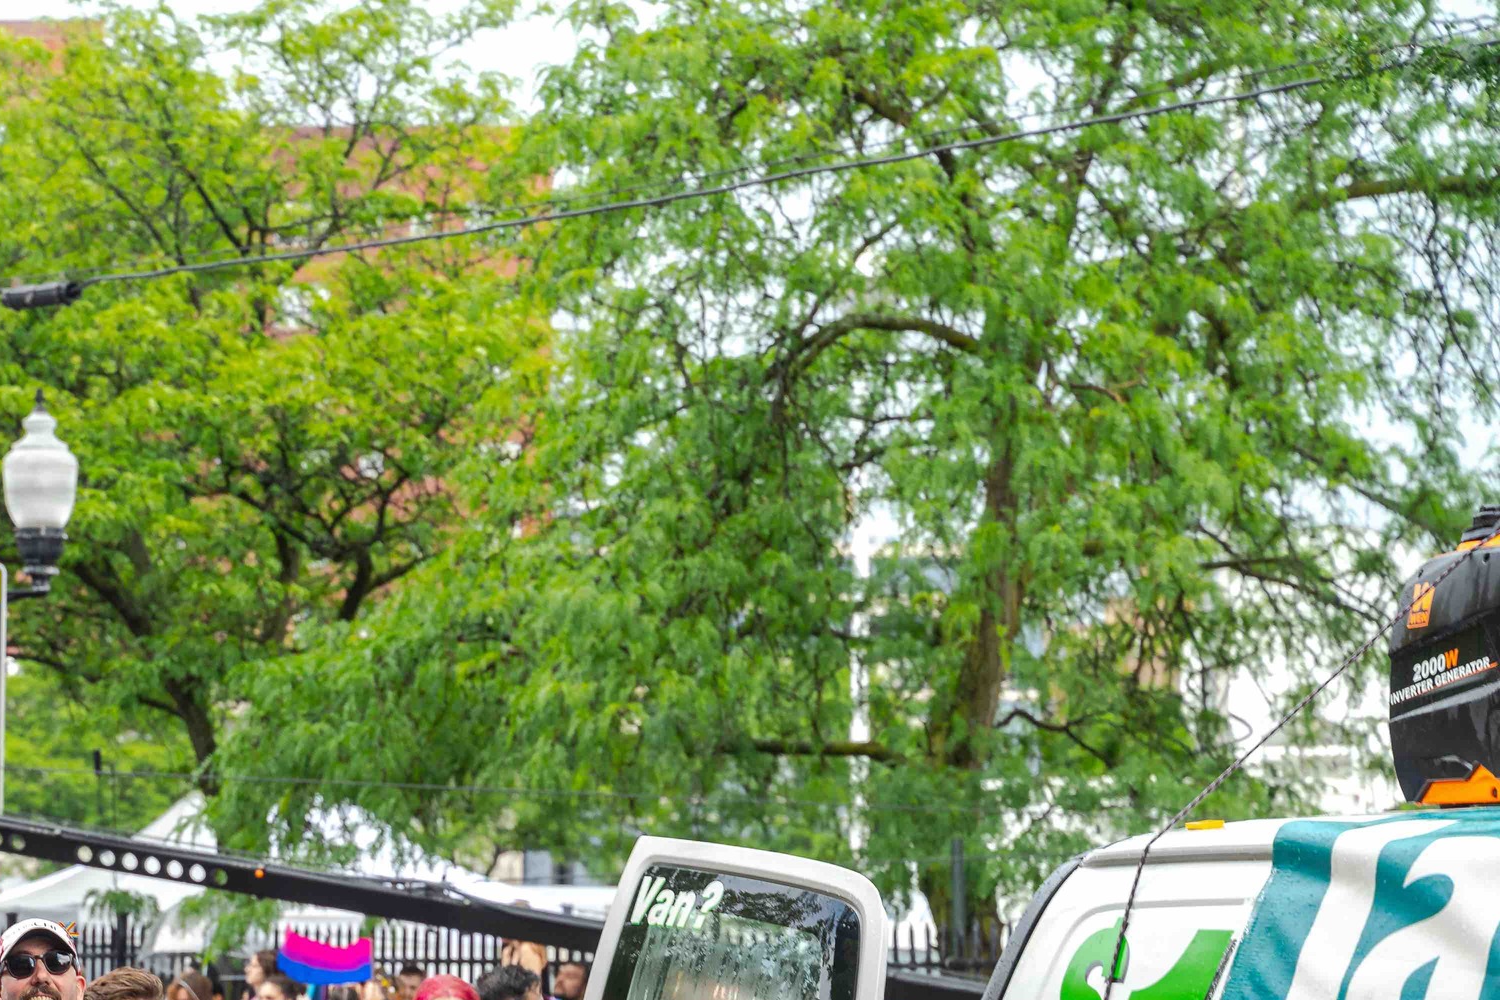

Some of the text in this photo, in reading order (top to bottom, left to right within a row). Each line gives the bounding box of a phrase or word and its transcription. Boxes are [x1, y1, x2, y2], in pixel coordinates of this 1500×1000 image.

[1389, 656, 1491, 706] INVERTER GENERATOR
[1412, 648, 1459, 683] 2000W
[631, 876, 725, 929] Van?
